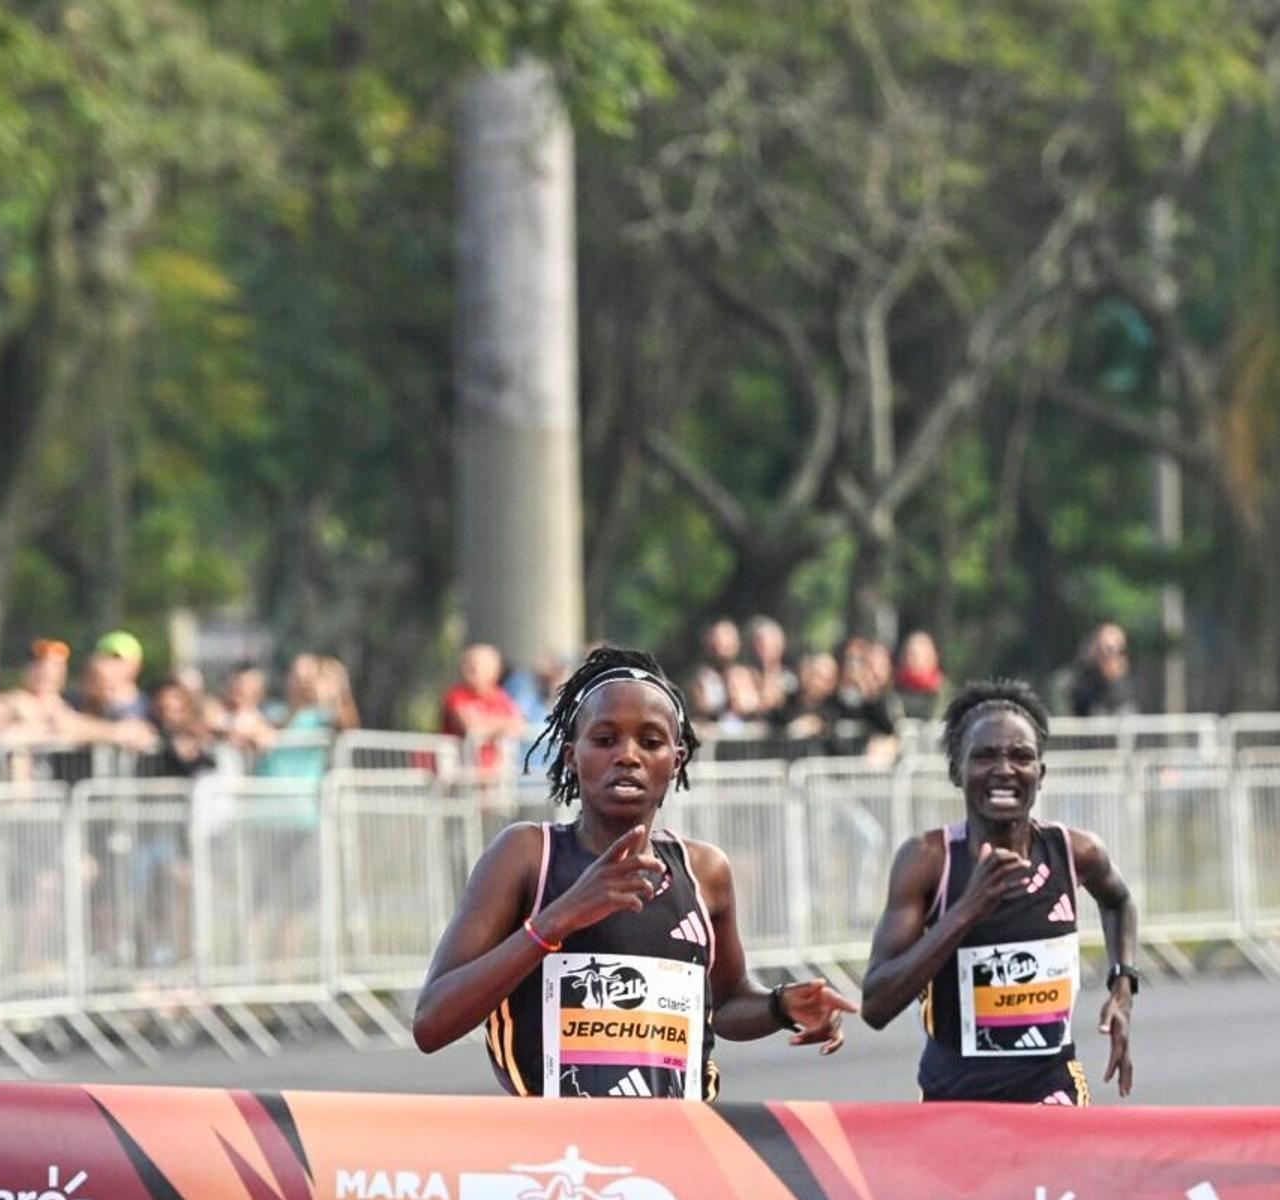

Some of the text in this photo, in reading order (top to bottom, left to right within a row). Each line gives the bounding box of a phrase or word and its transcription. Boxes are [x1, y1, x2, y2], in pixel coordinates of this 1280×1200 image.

[657, 995, 688, 1012] Claro
[993, 988, 1059, 1008] JEPTOO
[562, 1020, 688, 1045] JEPCHUMBA
[335, 1169, 449, 1200] MARA
